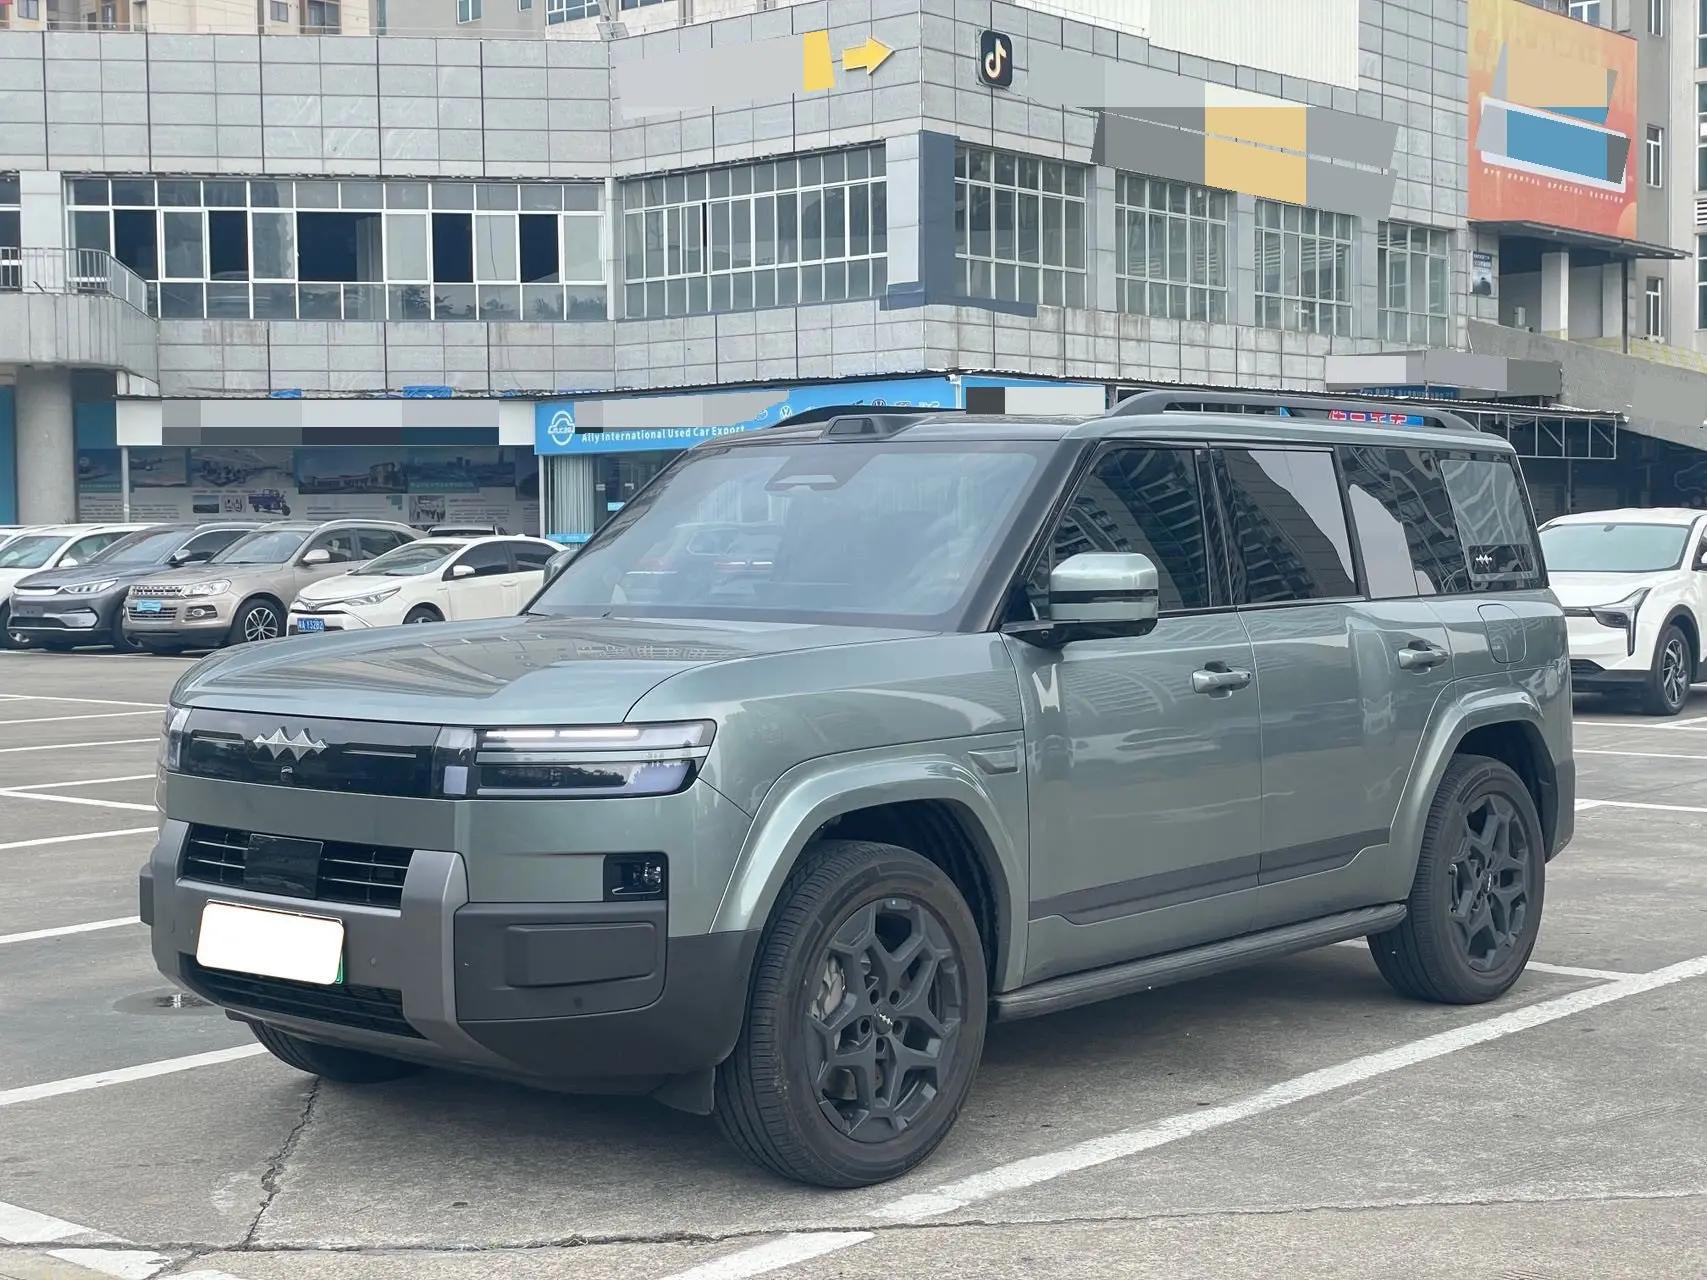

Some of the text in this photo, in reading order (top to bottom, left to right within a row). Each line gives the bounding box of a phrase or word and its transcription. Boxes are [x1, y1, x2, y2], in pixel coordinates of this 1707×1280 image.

[582, 425, 745, 445] Ally International Used Car Export
